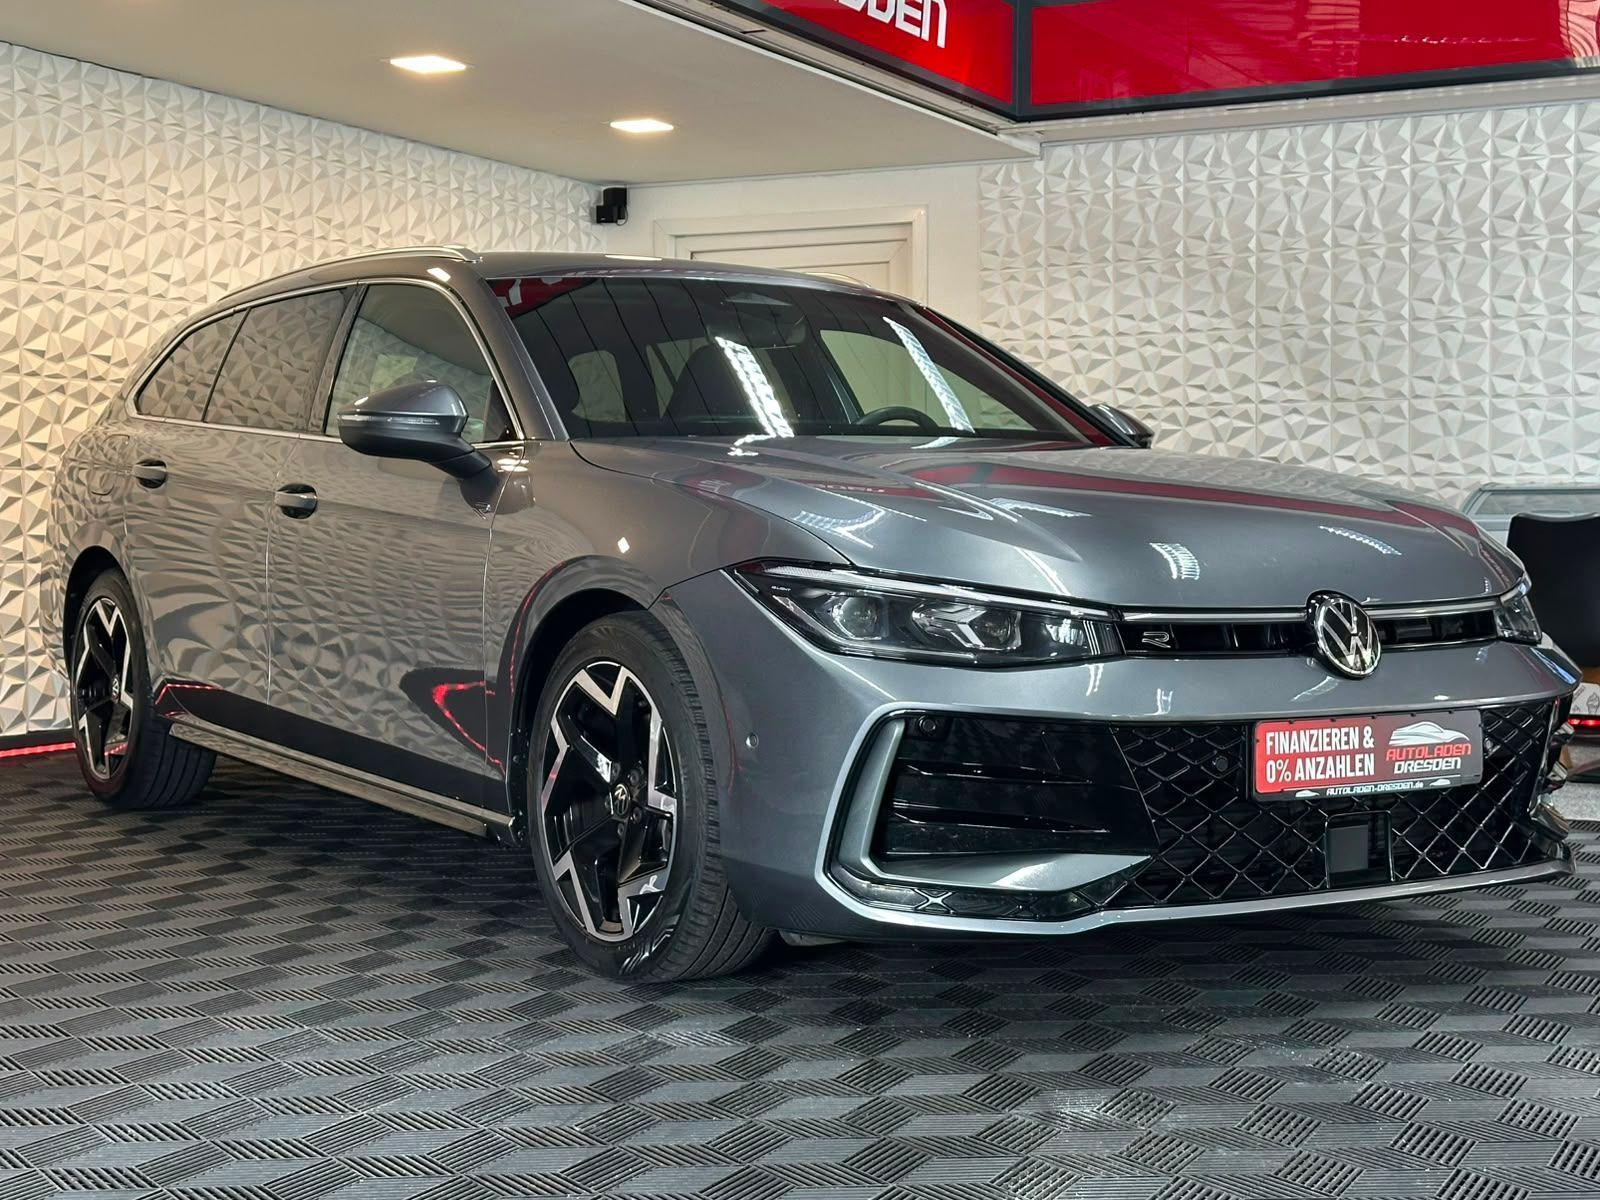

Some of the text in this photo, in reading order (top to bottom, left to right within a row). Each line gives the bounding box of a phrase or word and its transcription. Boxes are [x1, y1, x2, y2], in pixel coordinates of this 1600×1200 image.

[1265, 725, 1375, 755] FINANZIEREN &
[1386, 743, 1472, 761] AUTOLADEN
[1266, 753, 1375, 783] 0% ANZAHLEN
[1393, 756, 1461, 774] DRESDEN
